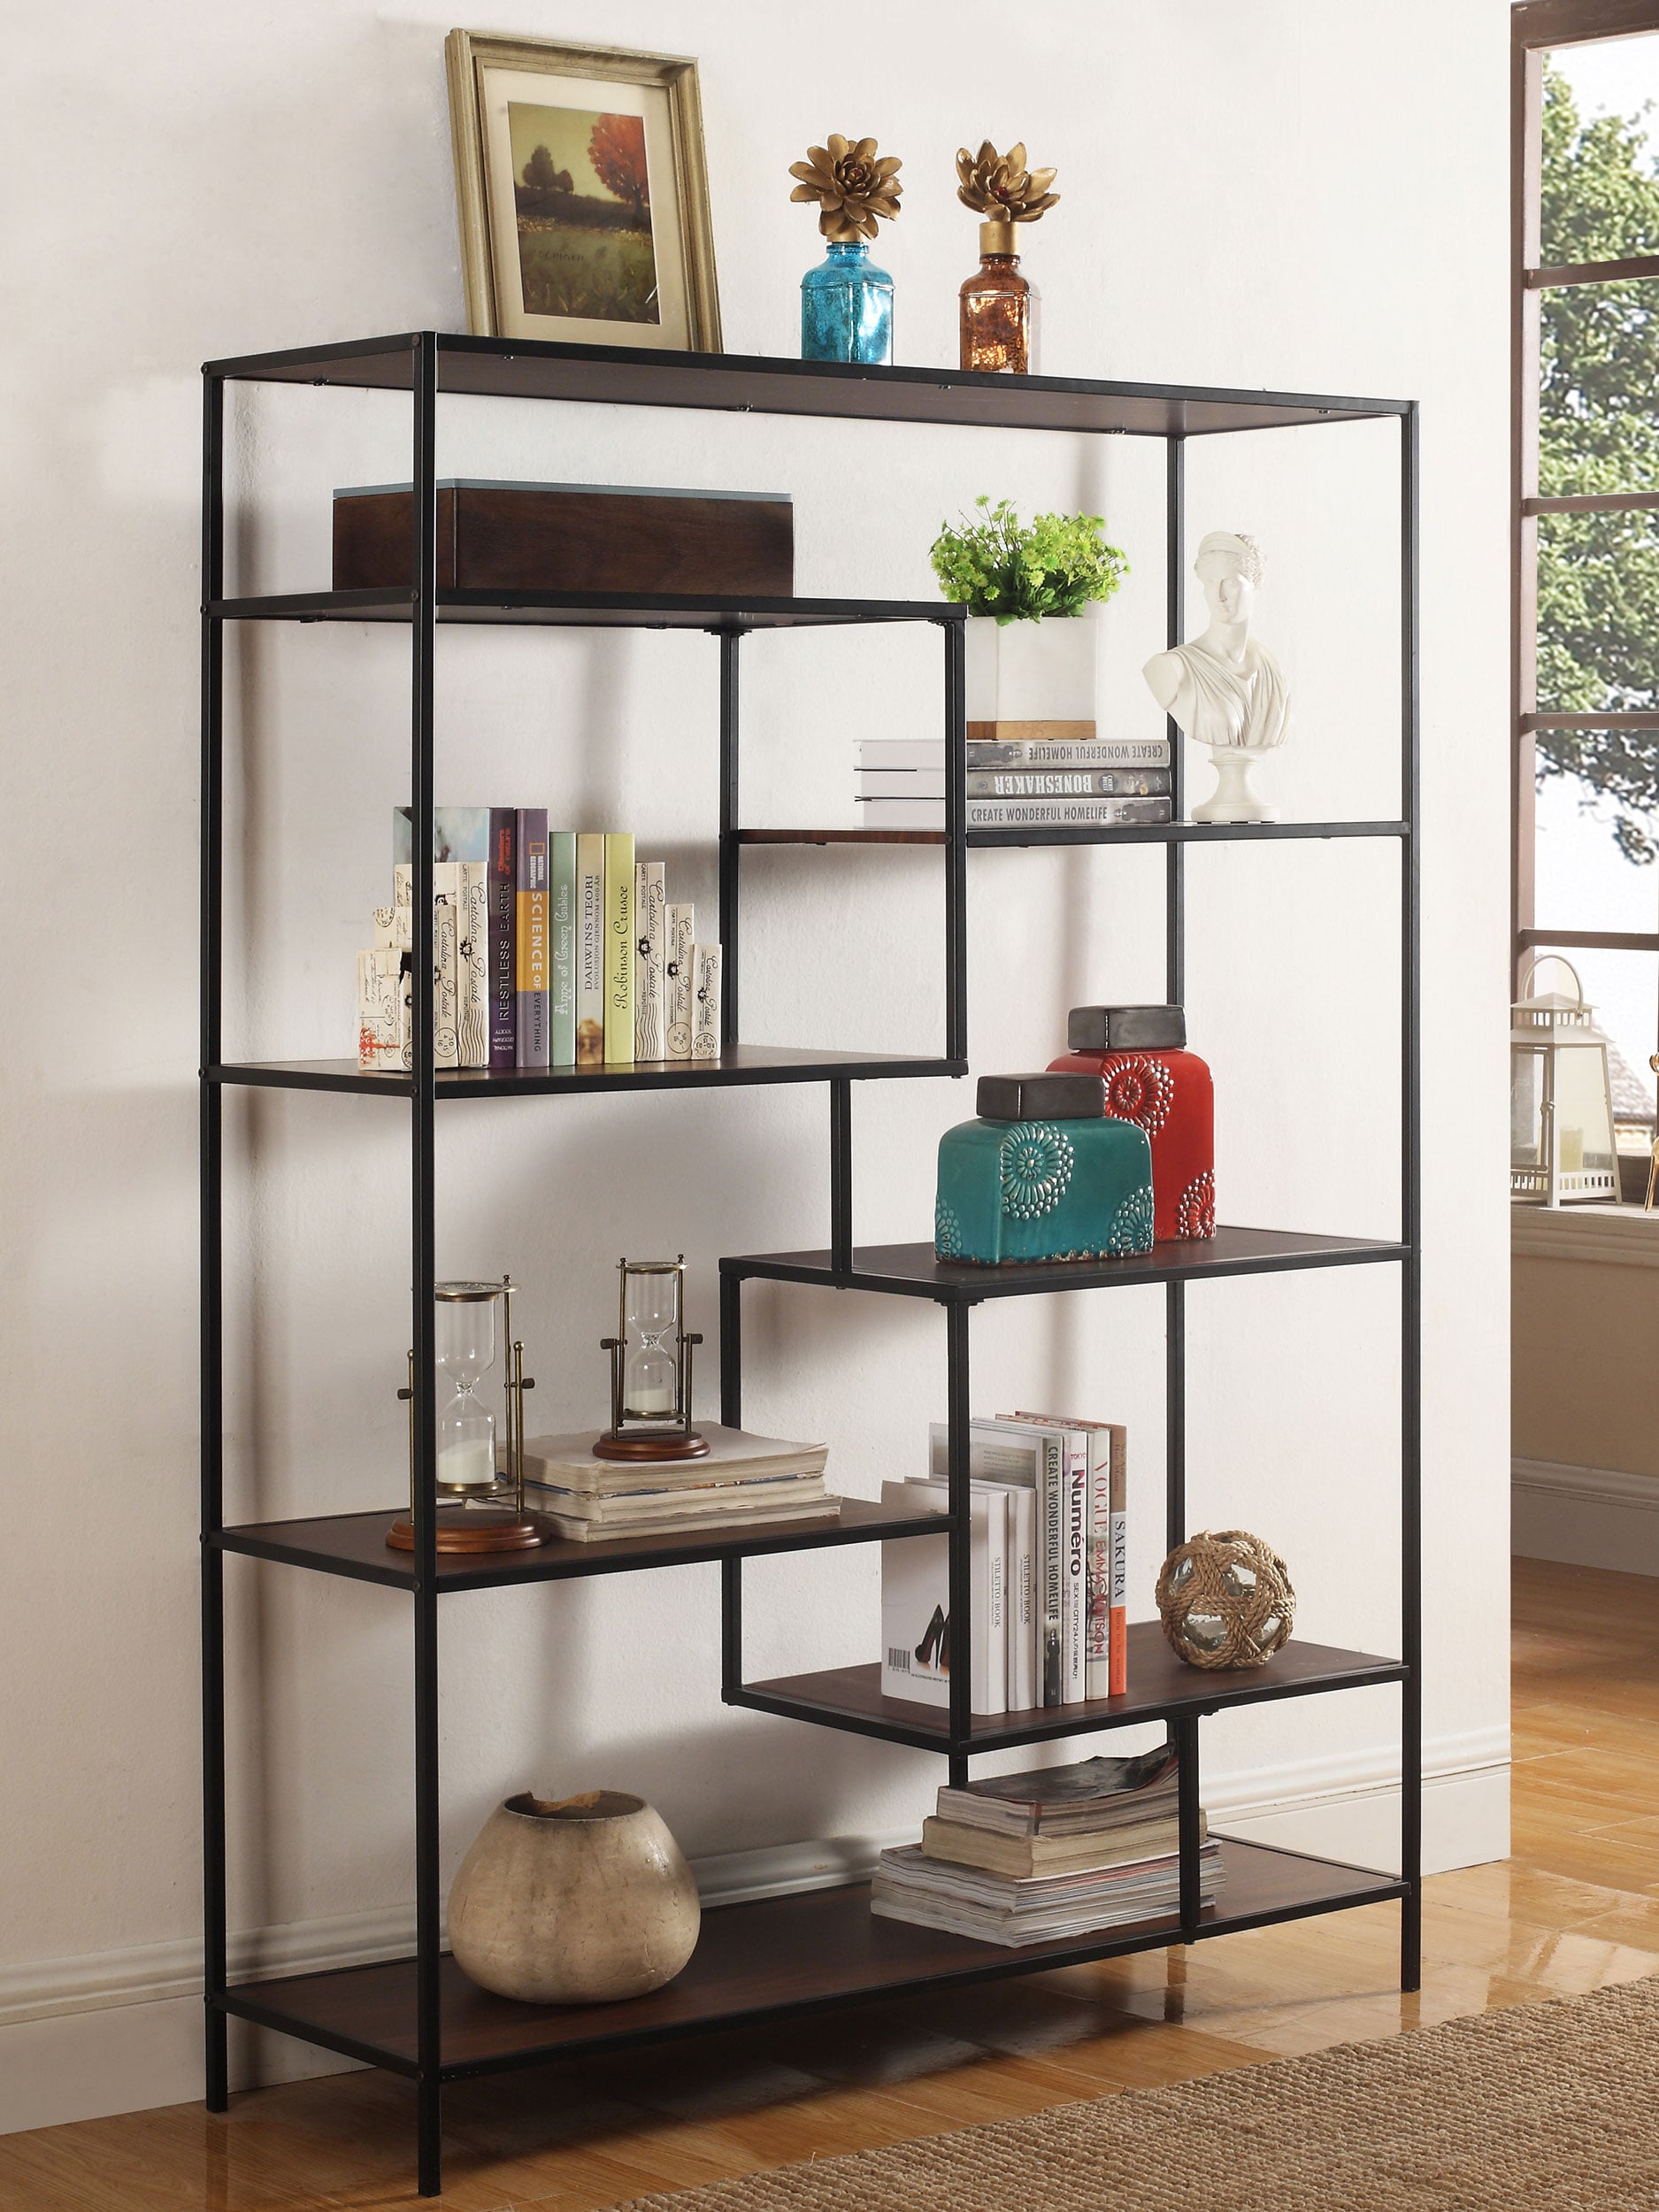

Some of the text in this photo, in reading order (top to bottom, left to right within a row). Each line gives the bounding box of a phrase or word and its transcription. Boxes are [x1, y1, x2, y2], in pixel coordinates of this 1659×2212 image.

[995, 774, 1093, 795] BONESHAKER
[1028, 745, 1163, 761] CREATE WONDERFUL HOMELIFE
[971, 807, 1108, 822] CREATE WONDERFUL HOMELIFE
[532, 893, 542, 971] SCIENCE
[585, 876, 594, 919] TEORI
[470, 881, 486, 1003] Cartolina Postale
[499, 883, 511, 1021] RESTLESS EARTH
[555, 884, 572, 1015] Anne of Green Gables
[613, 886, 628, 1009] Robinson Crusoe
[649, 880, 664, 1002] Cartolina Postale
[677, 918, 692, 1013] Cartolina Postale
[534, 975, 541, 989] OF
[1048, 1446, 1059, 1621] CREATE WONDERFUL HOMELIFE
[1071, 1469, 1086, 1577] Numéro
[1094, 1461, 1108, 1533] VOGUE
[1095, 1540, 1106, 1587] EMMA
[1115, 1521, 1125, 1599] SAKURA
